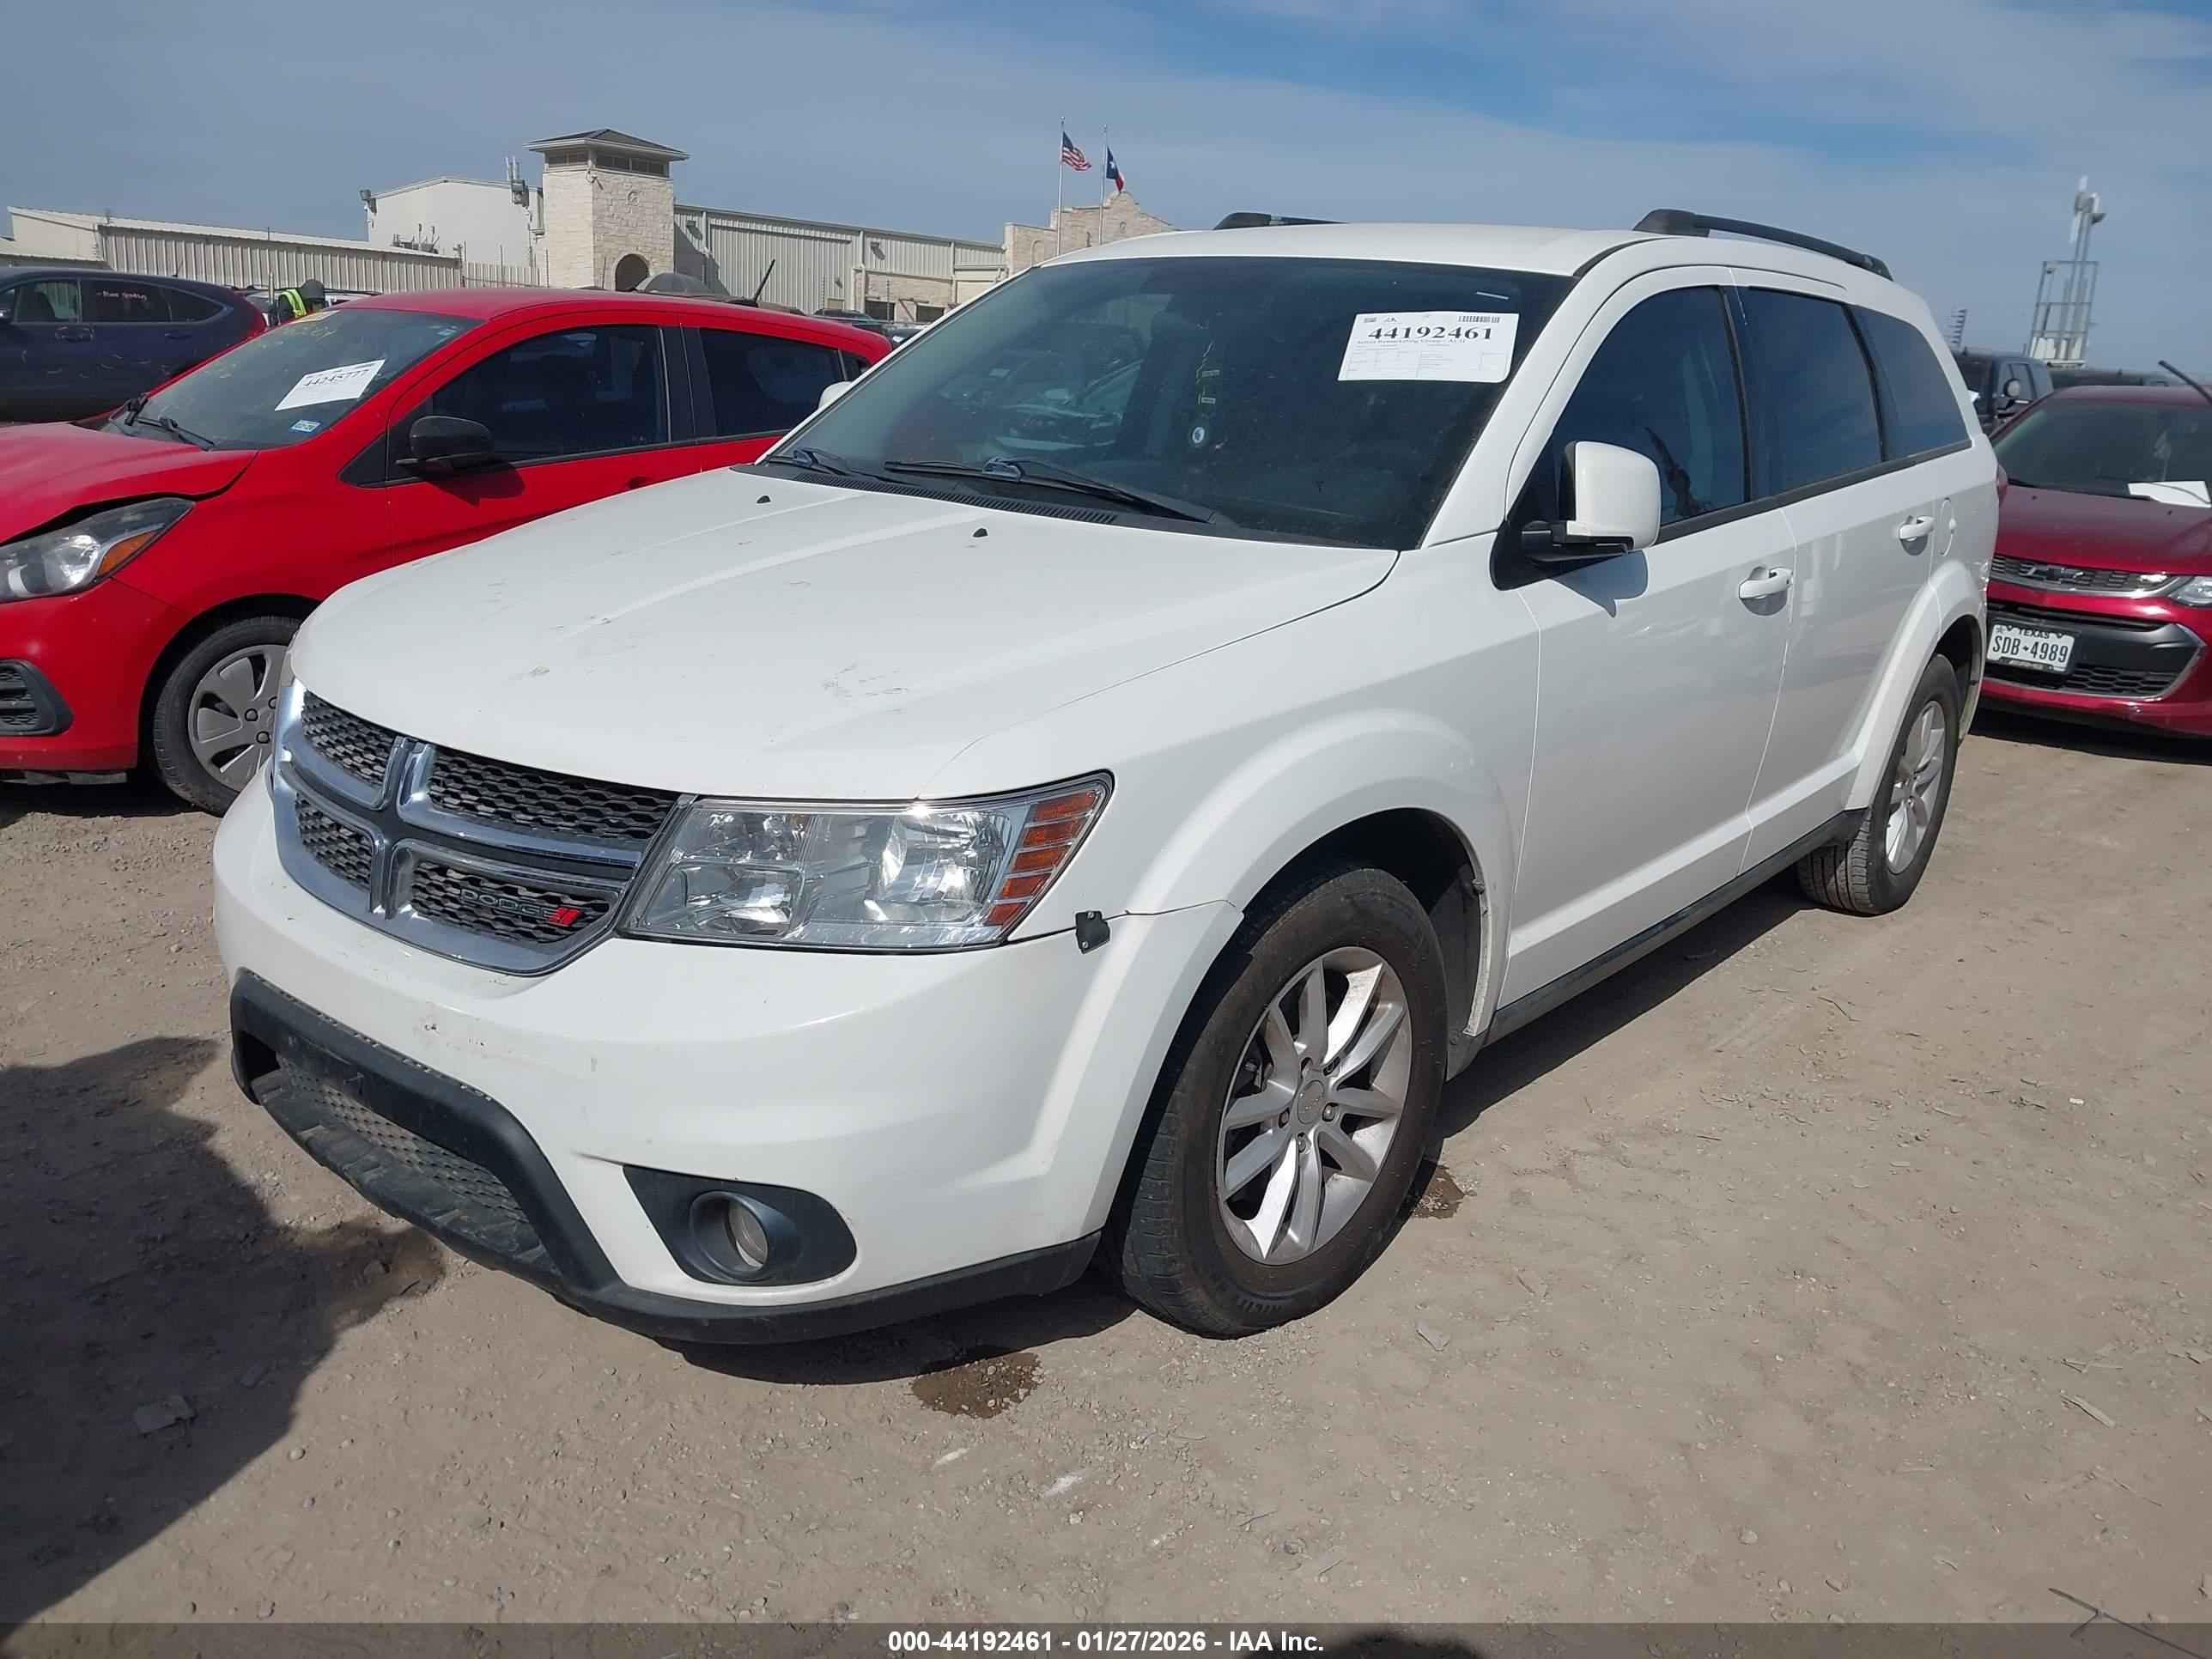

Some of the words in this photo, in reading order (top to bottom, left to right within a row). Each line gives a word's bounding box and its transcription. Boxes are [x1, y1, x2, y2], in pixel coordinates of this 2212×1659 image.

[1368, 326, 1492, 340] 44192461
[2018, 629, 2050, 639] TEXAS
[459, 888, 557, 917] DODGE
